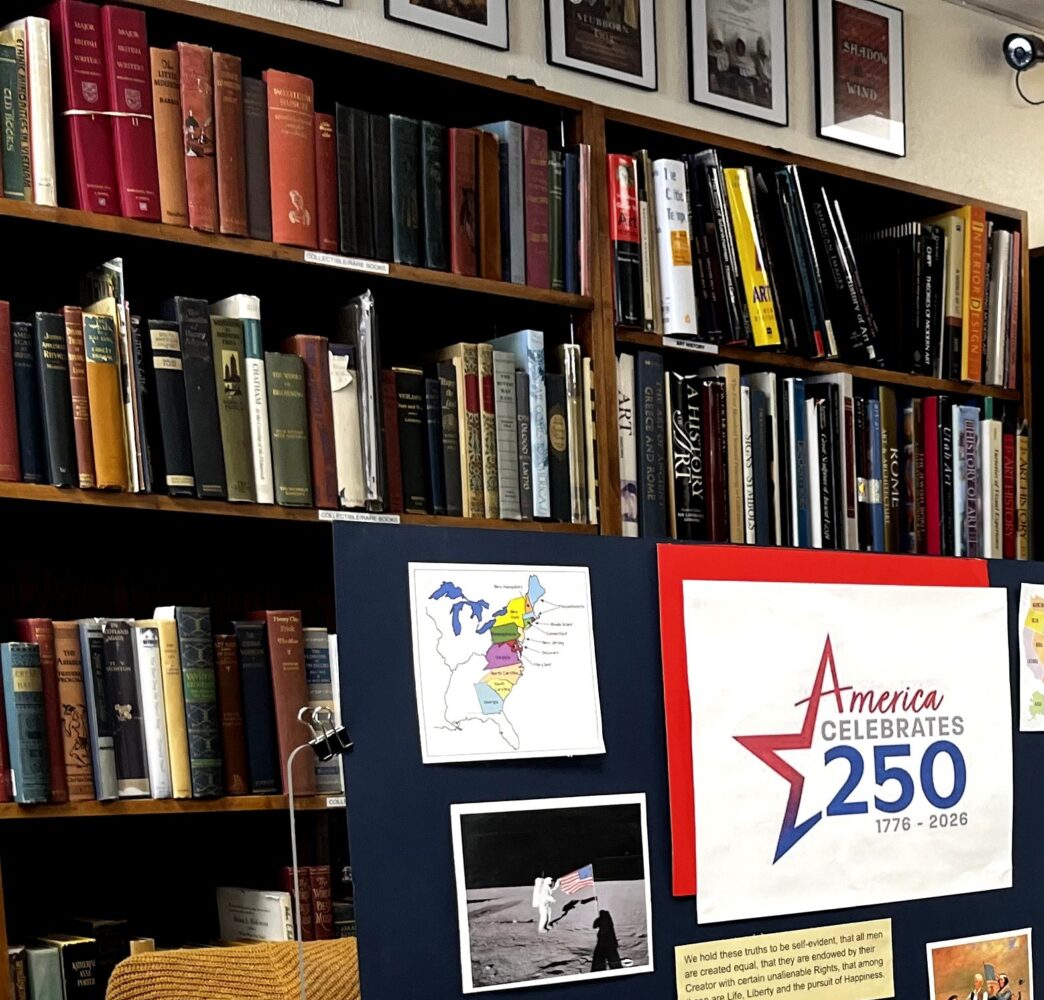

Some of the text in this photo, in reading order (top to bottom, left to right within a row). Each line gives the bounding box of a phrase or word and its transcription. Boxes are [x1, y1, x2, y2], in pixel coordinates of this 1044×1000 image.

[366, 263, 387, 272] BOOKS
[969, 221, 985, 354] INTERIOR DESIGN
[860, 327, 870, 342] Art
[618, 390, 632, 435] ART
[687, 385, 704, 500] A HISTORY
[890, 448, 899, 508] ROME
[795, 633, 944, 714] America
[821, 715, 965, 741] CELEBRATES
[824, 740, 967, 816] 250
[875, 817, 911, 834] 1776
[929, 812, 968, 829] 2026
[684, 931, 883, 964] We hold these truths to be self-evident, that all men
[685, 944, 875, 978] are created equal, that they are endowed by their
[685, 957, 884, 993] Creator with certain unalienable Rights, that among
[727, 989, 745, 1000] Life,
[747, 986, 774, 999] Liberty
[776, 984, 791, 994] and
[793, 981, 805, 991] the
[807, 979, 833, 991] pursuit
[835, 976, 843, 985] of
